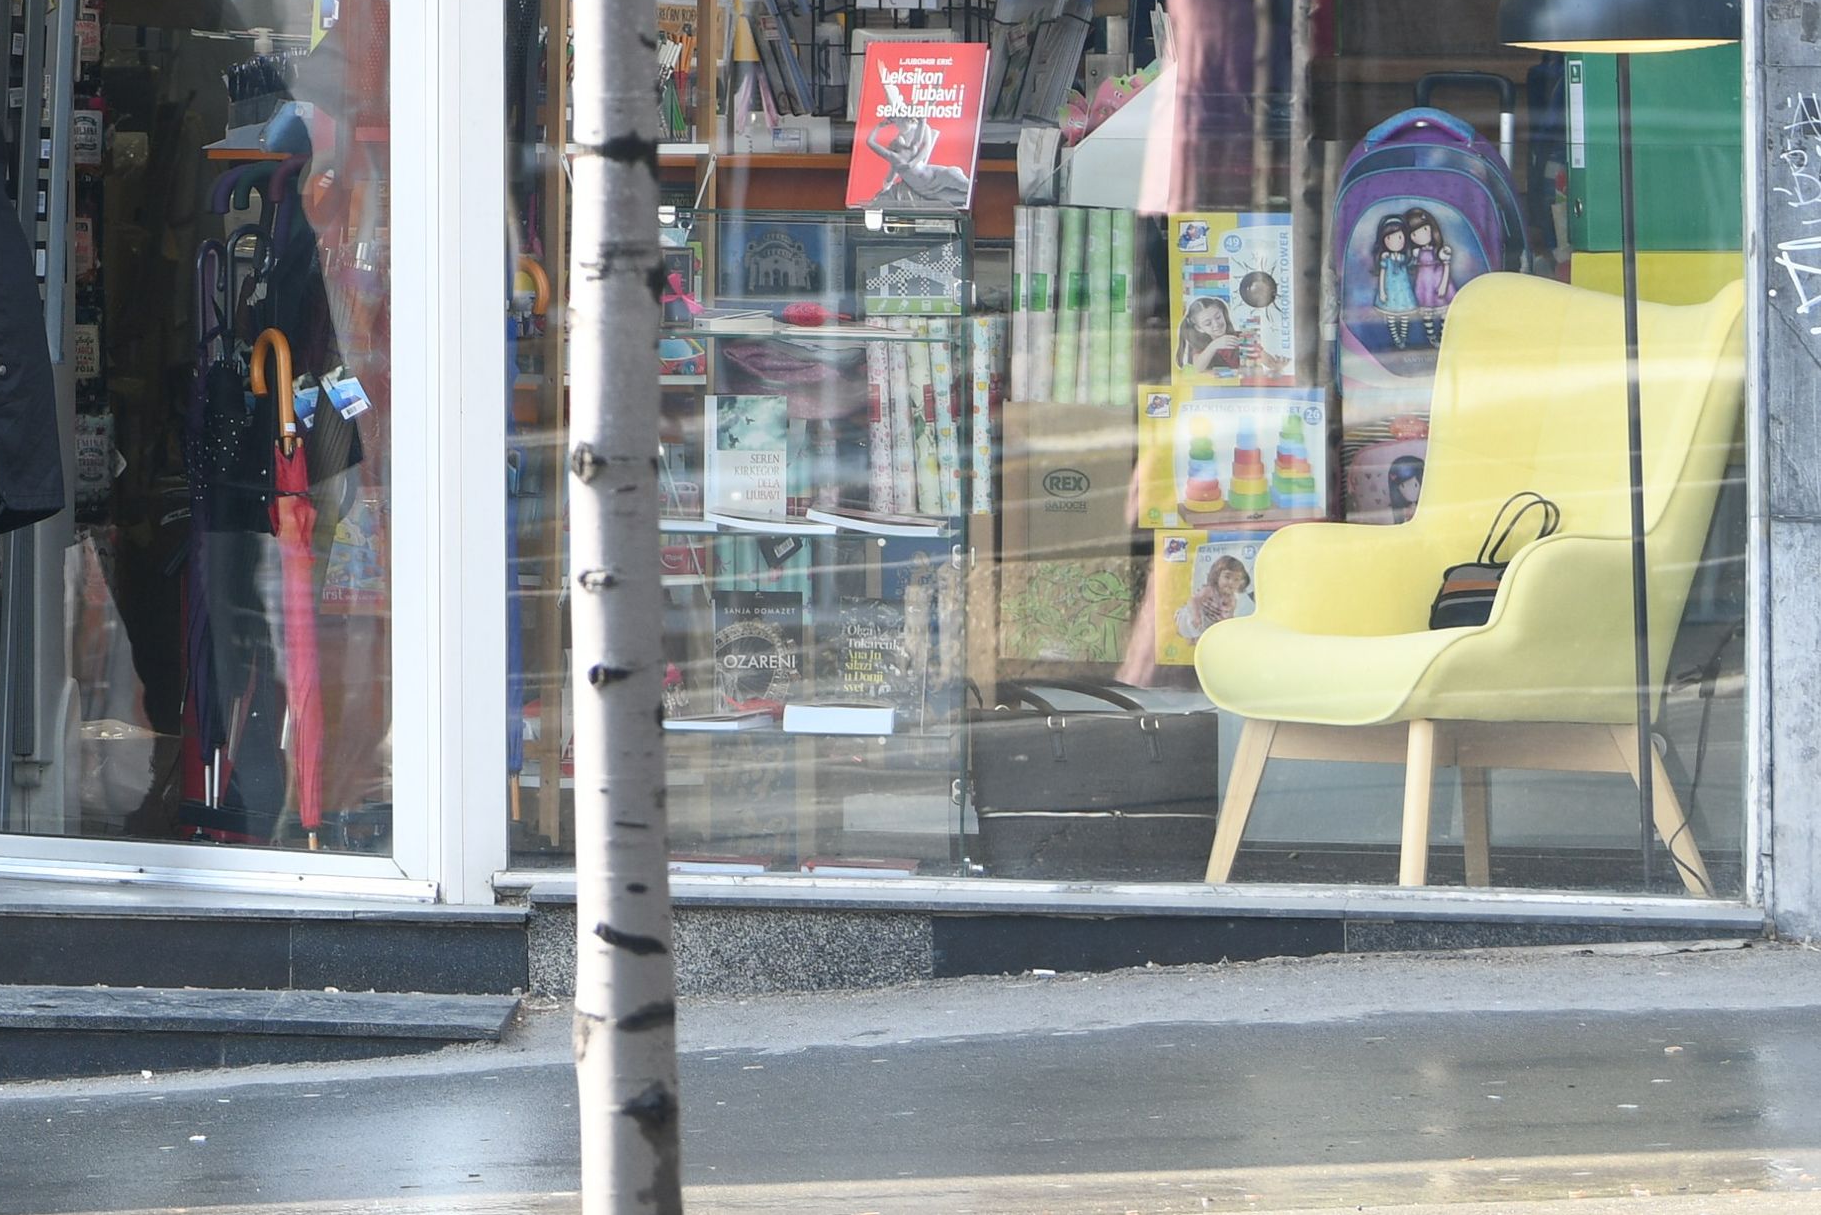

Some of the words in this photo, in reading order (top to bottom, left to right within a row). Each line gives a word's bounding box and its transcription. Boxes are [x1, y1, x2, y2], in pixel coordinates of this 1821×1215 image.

[899, 57, 935, 65] LJUBOMIR
[881, 68, 943, 84] Leksikon
[911, 84, 957, 103] ljubavi
[958, 84, 965, 101] i
[876, 102, 963, 118] seksualnosti
[1280, 232, 1289, 271] TOWER
[1281, 274, 1291, 349] ELECTRONIC
[750, 453, 780, 464] SEREN
[734, 465, 780, 476] KIRKEGOR
[1049, 476, 1084, 491] REX
[745, 490, 780, 501] LJUBAVI
[724, 607, 751, 615] SANJA
[754, 607, 796, 615] DOMAZET
[723, 654, 796, 669] OZARENI
